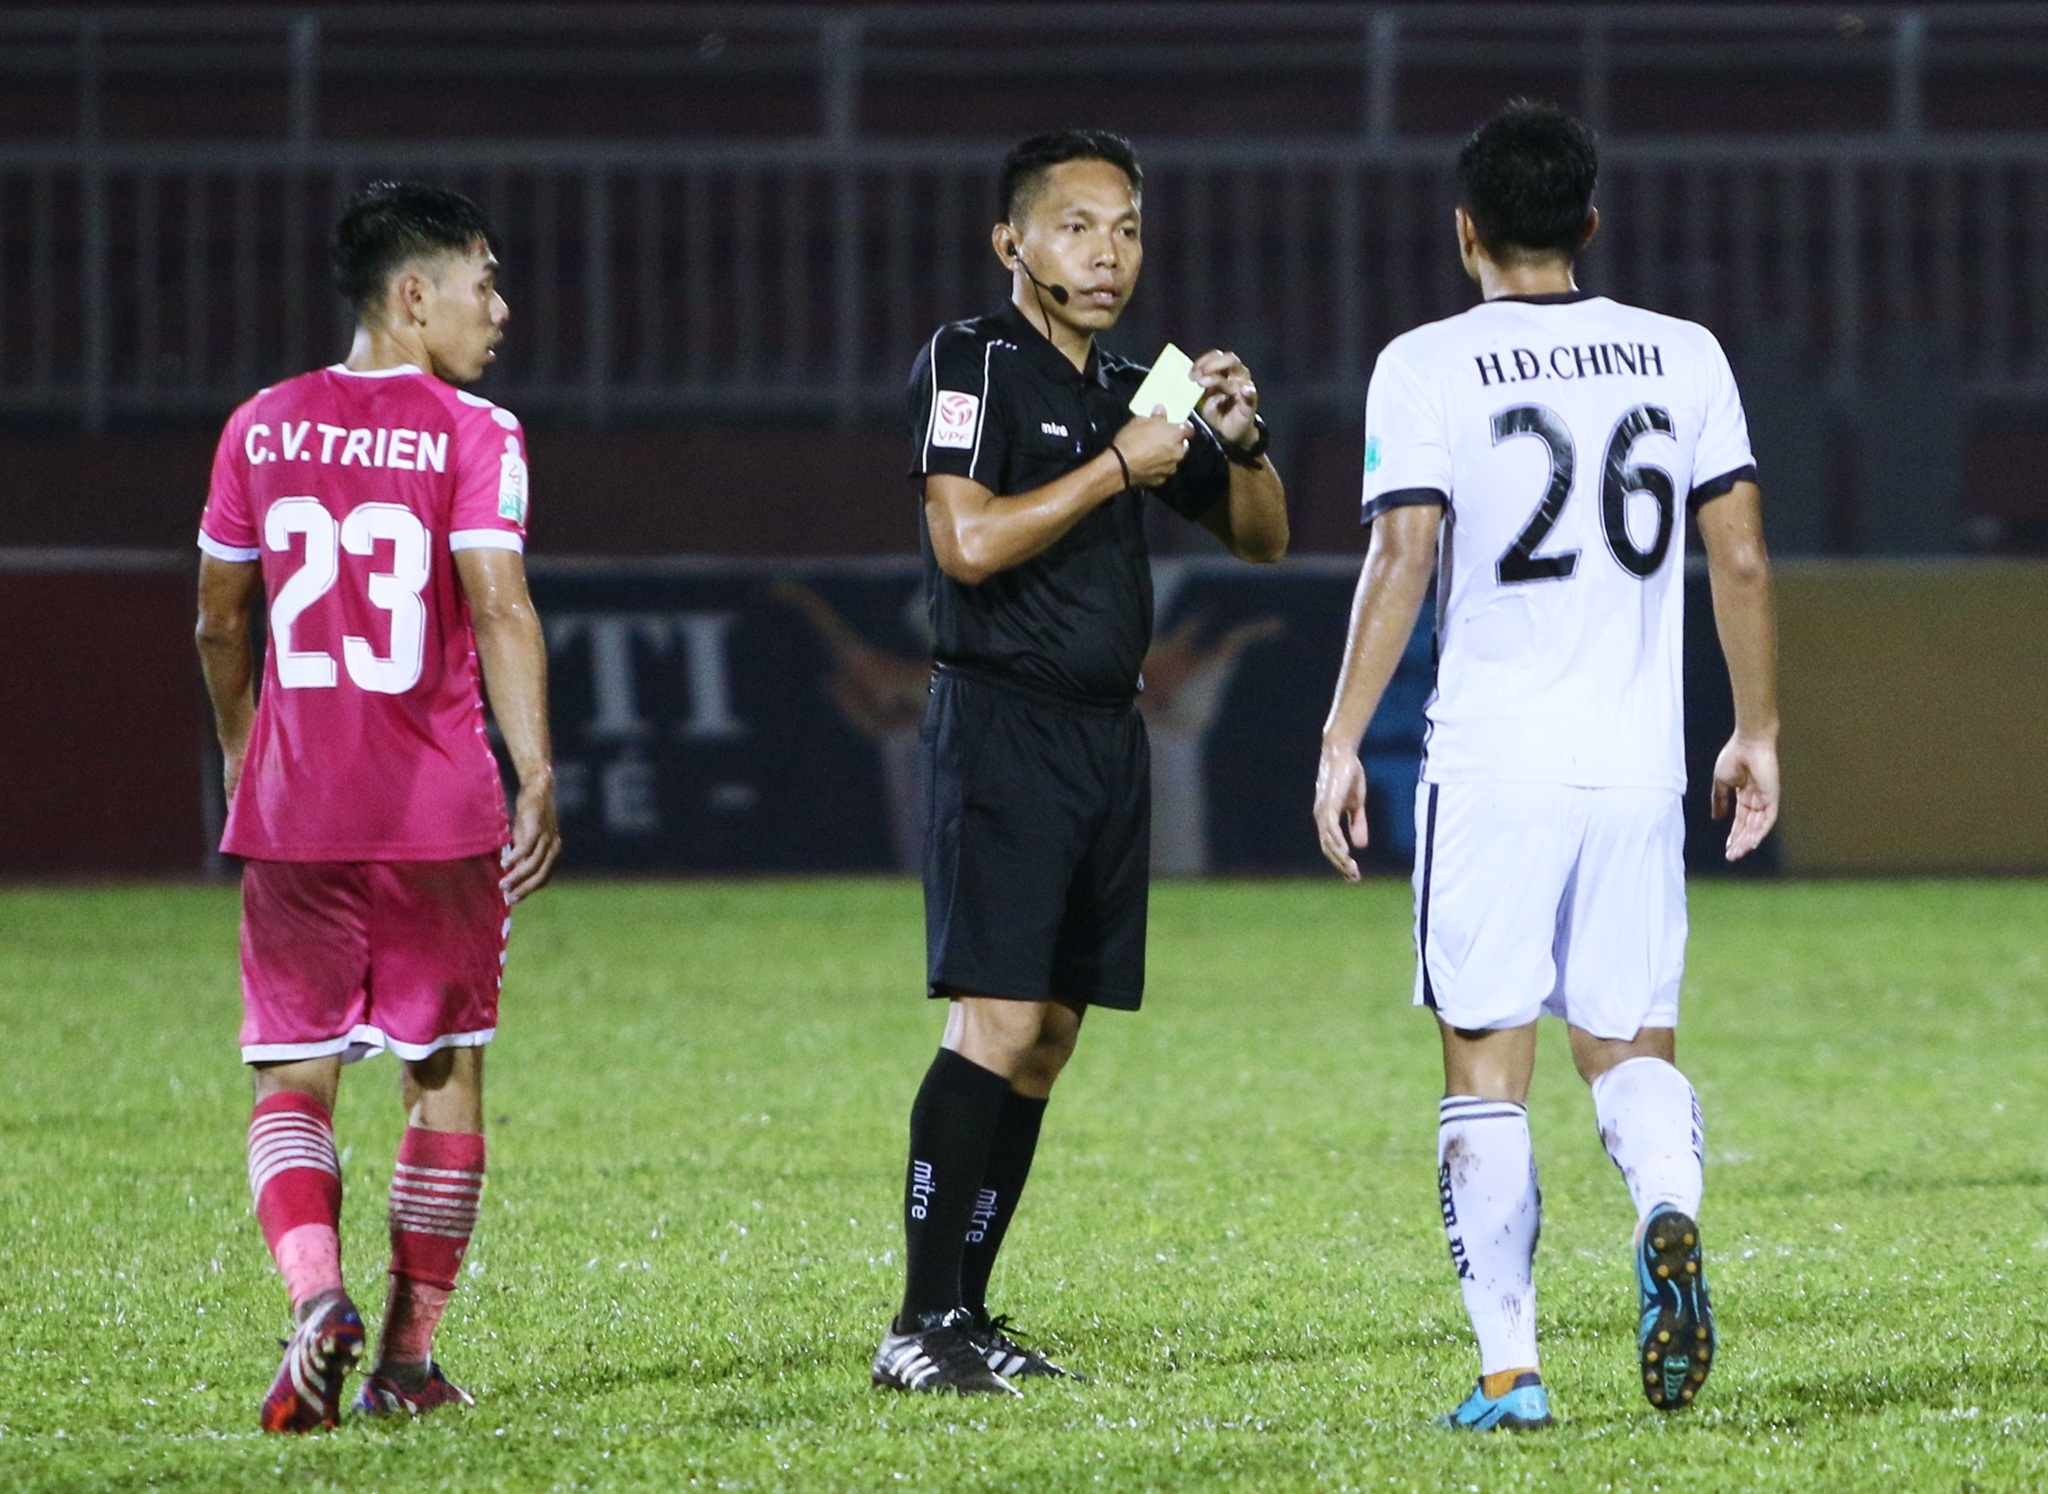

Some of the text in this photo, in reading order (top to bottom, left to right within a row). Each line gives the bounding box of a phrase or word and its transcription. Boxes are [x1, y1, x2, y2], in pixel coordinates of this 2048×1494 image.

[1474, 342, 1665, 386] H.Đ.CHINH
[244, 421, 449, 474] C.V.TRIEN
[937, 429, 969, 443] VPF
[1490, 402, 1677, 586] 26
[263, 495, 431, 695] 23
[911, 1159, 936, 1220] mitre
[965, 1188, 998, 1243] mitre
